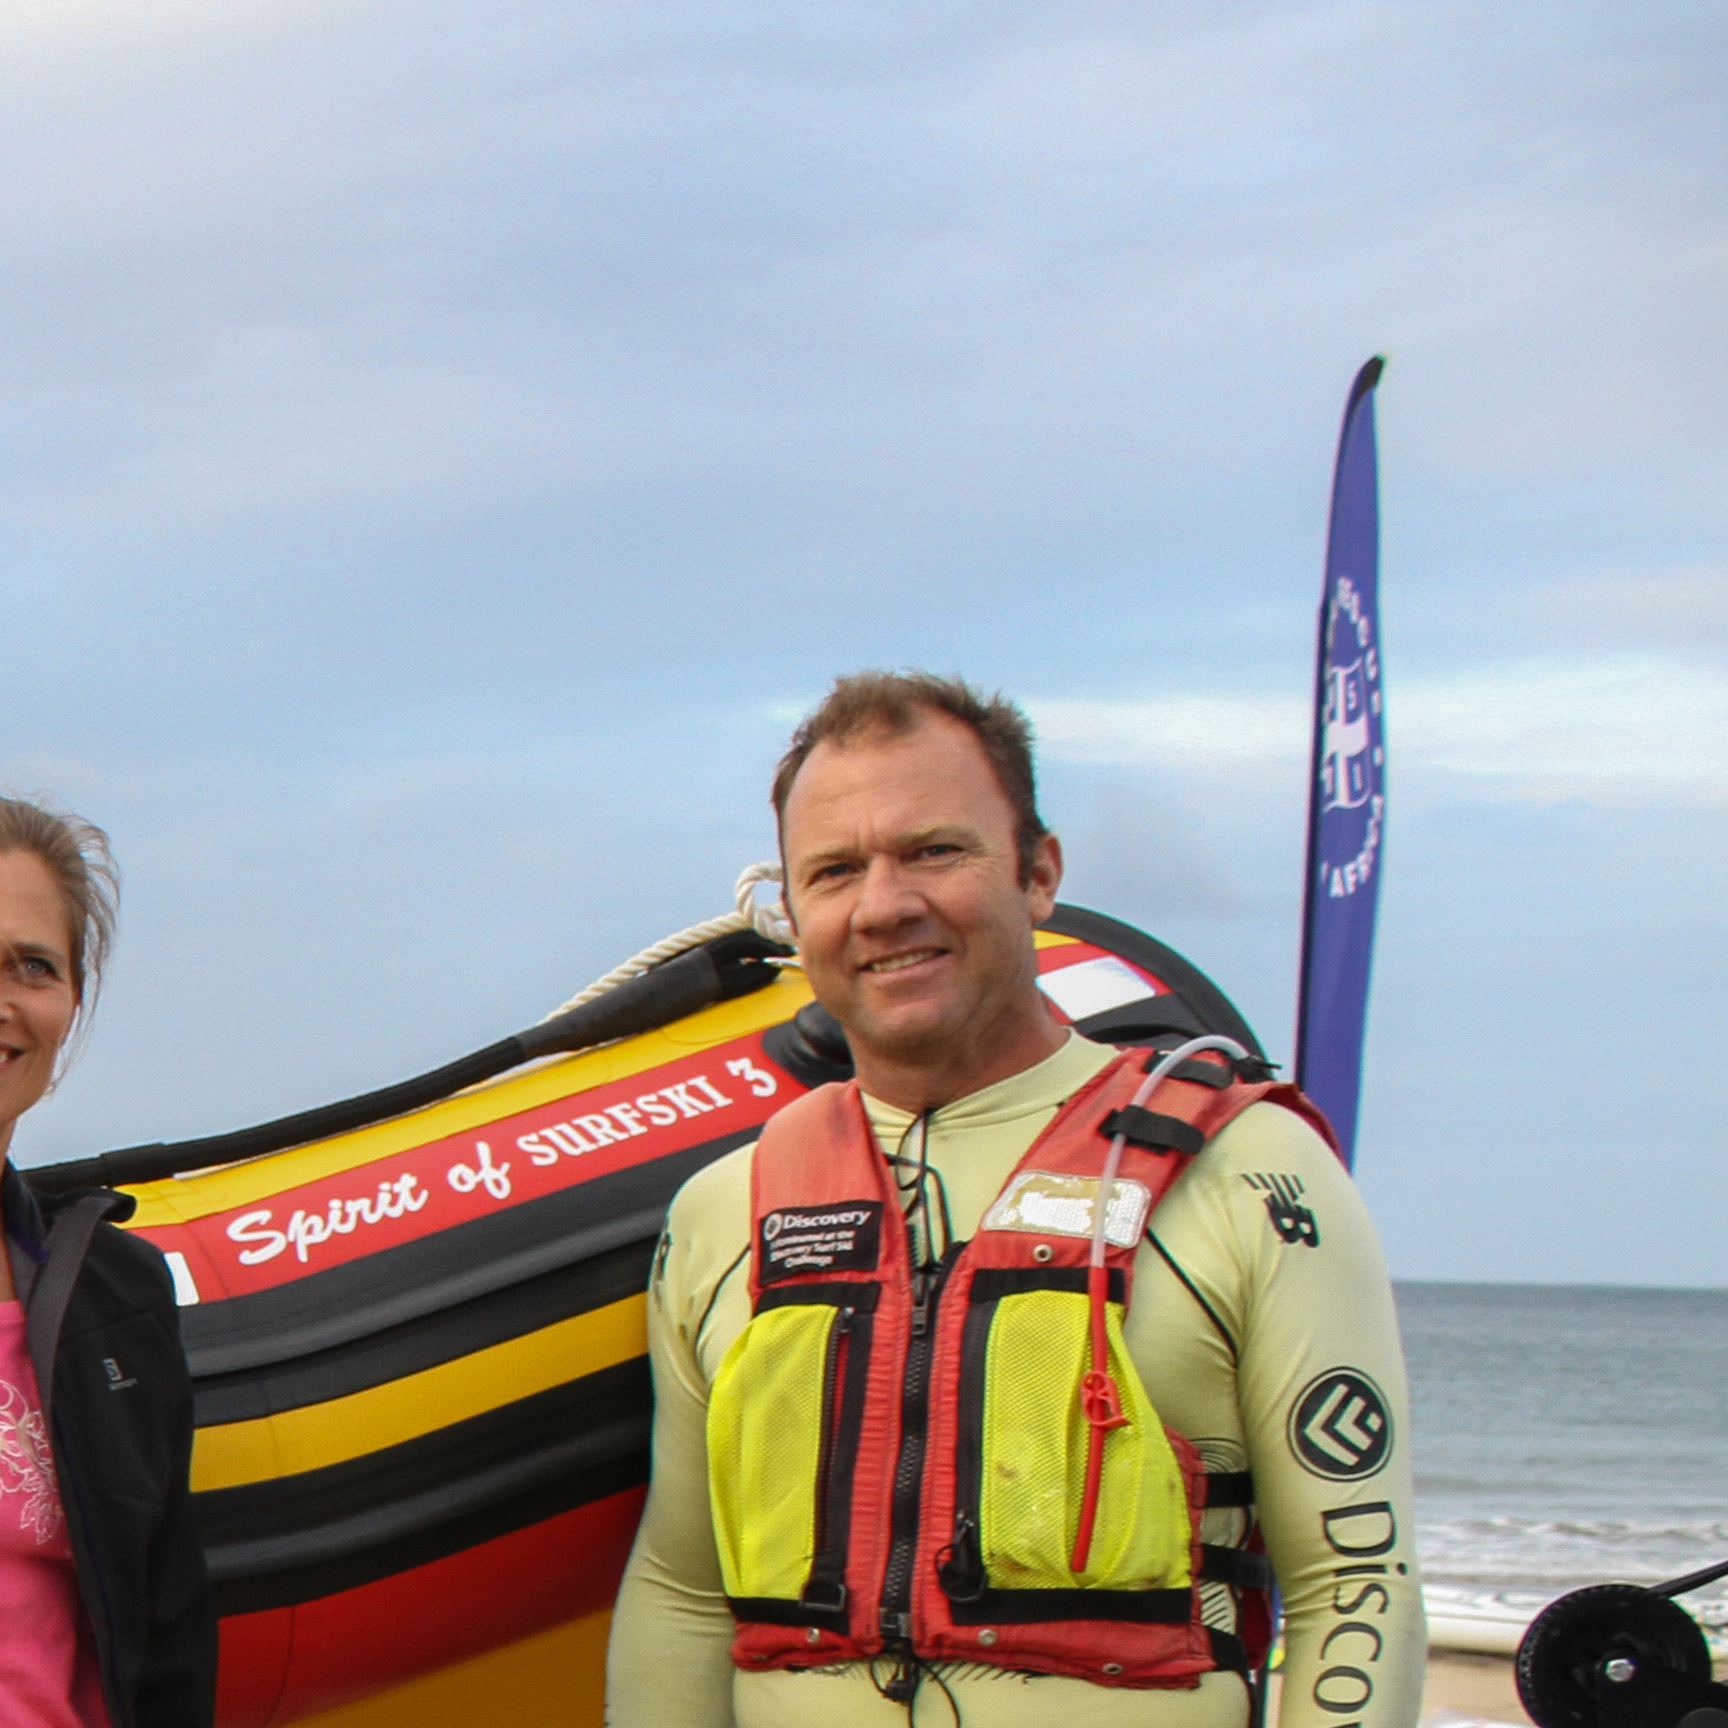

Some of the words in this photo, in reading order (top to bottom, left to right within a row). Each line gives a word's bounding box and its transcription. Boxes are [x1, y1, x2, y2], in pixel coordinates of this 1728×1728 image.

[226, 1172, 429, 1265] Spirit
[447, 1141, 511, 1200] of
[516, 1074, 734, 1168] SURFSKI
[725, 1056, 778, 1099] 3
[782, 1210, 873, 1230] Discovery
